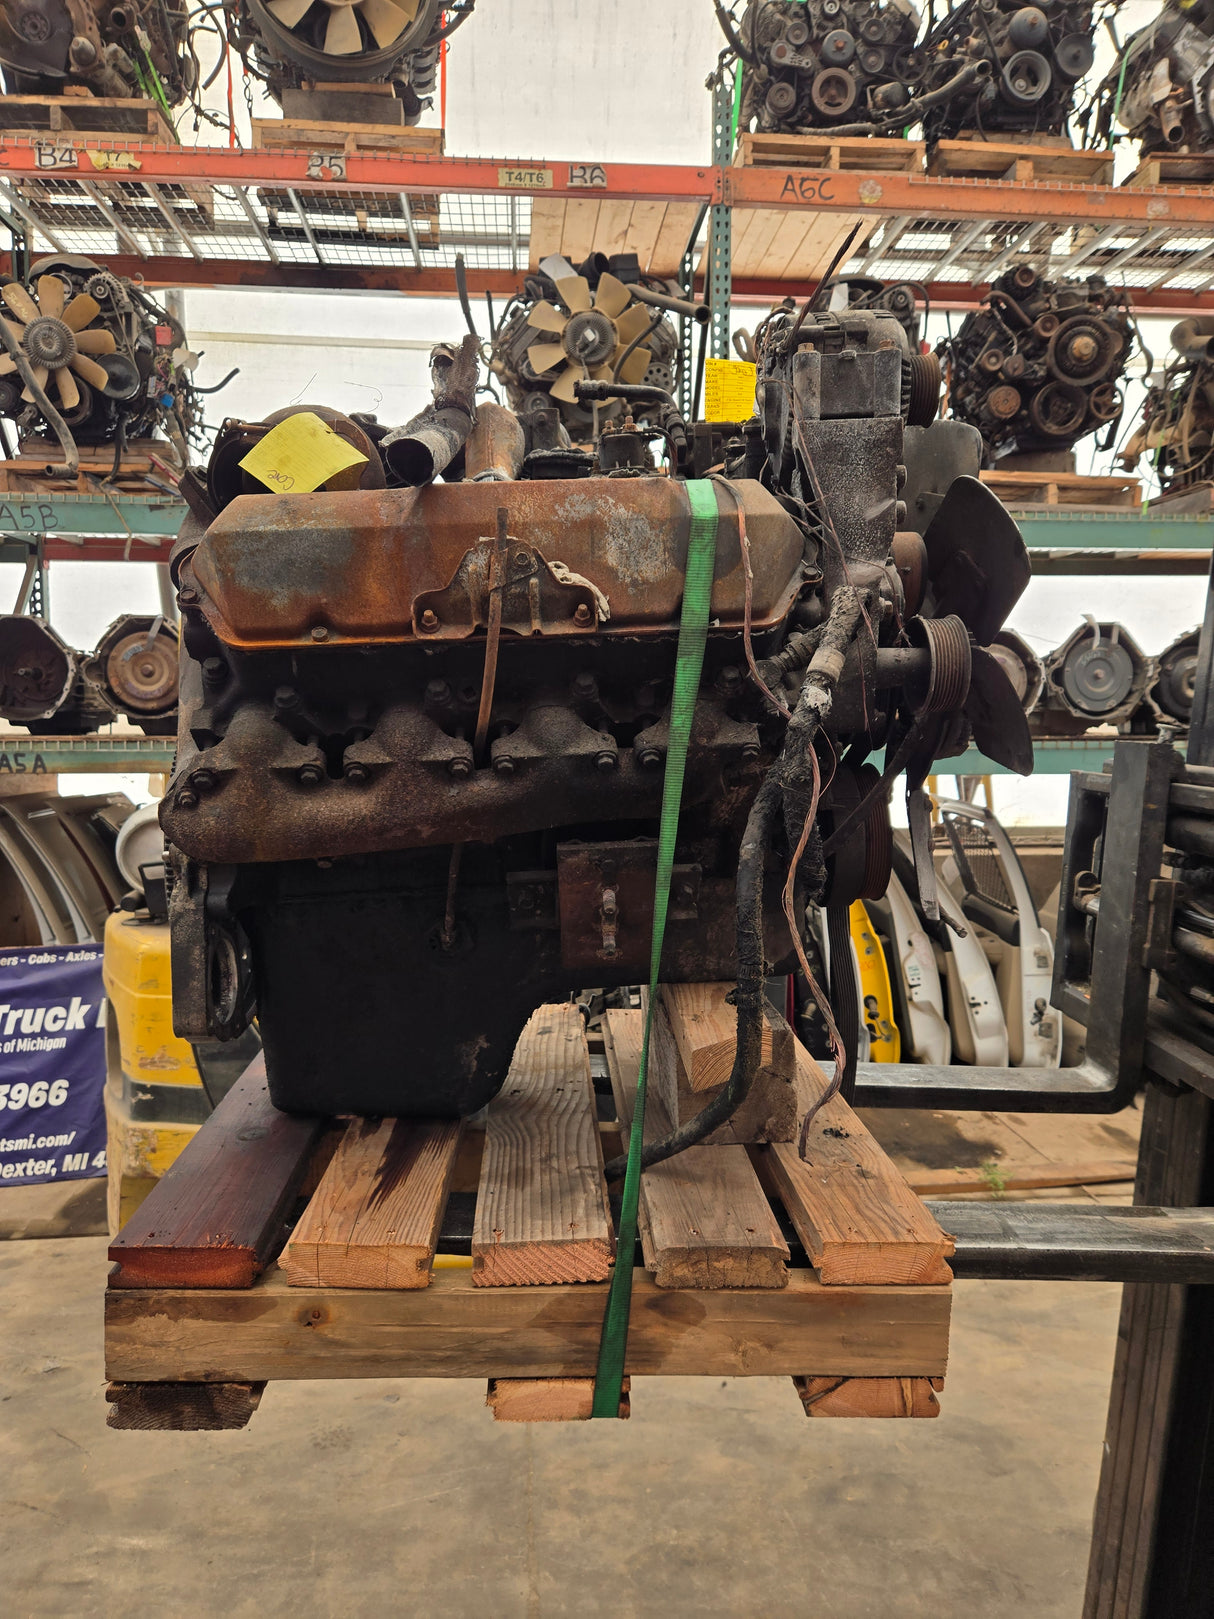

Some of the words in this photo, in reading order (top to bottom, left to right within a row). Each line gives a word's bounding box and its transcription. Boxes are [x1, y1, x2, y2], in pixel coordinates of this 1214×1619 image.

[37, 141, 76, 168] B4
[505, 171, 544, 184] T4/T6
[780, 174, 835, 201] A6C
[0, 503, 58, 531] A5B
[0, 752, 47, 774] A5A
[28, 952, 57, 965] Cabs
[65, 949, 97, 962] Axles
[3, 1038, 16, 1053] of
[16, 1036, 67, 1052] Michigan
[0, 1130, 76, 1152] tsmi.com/
[0, 1158, 57, 1178] exter,
[62, 1152, 90, 1172] MI
